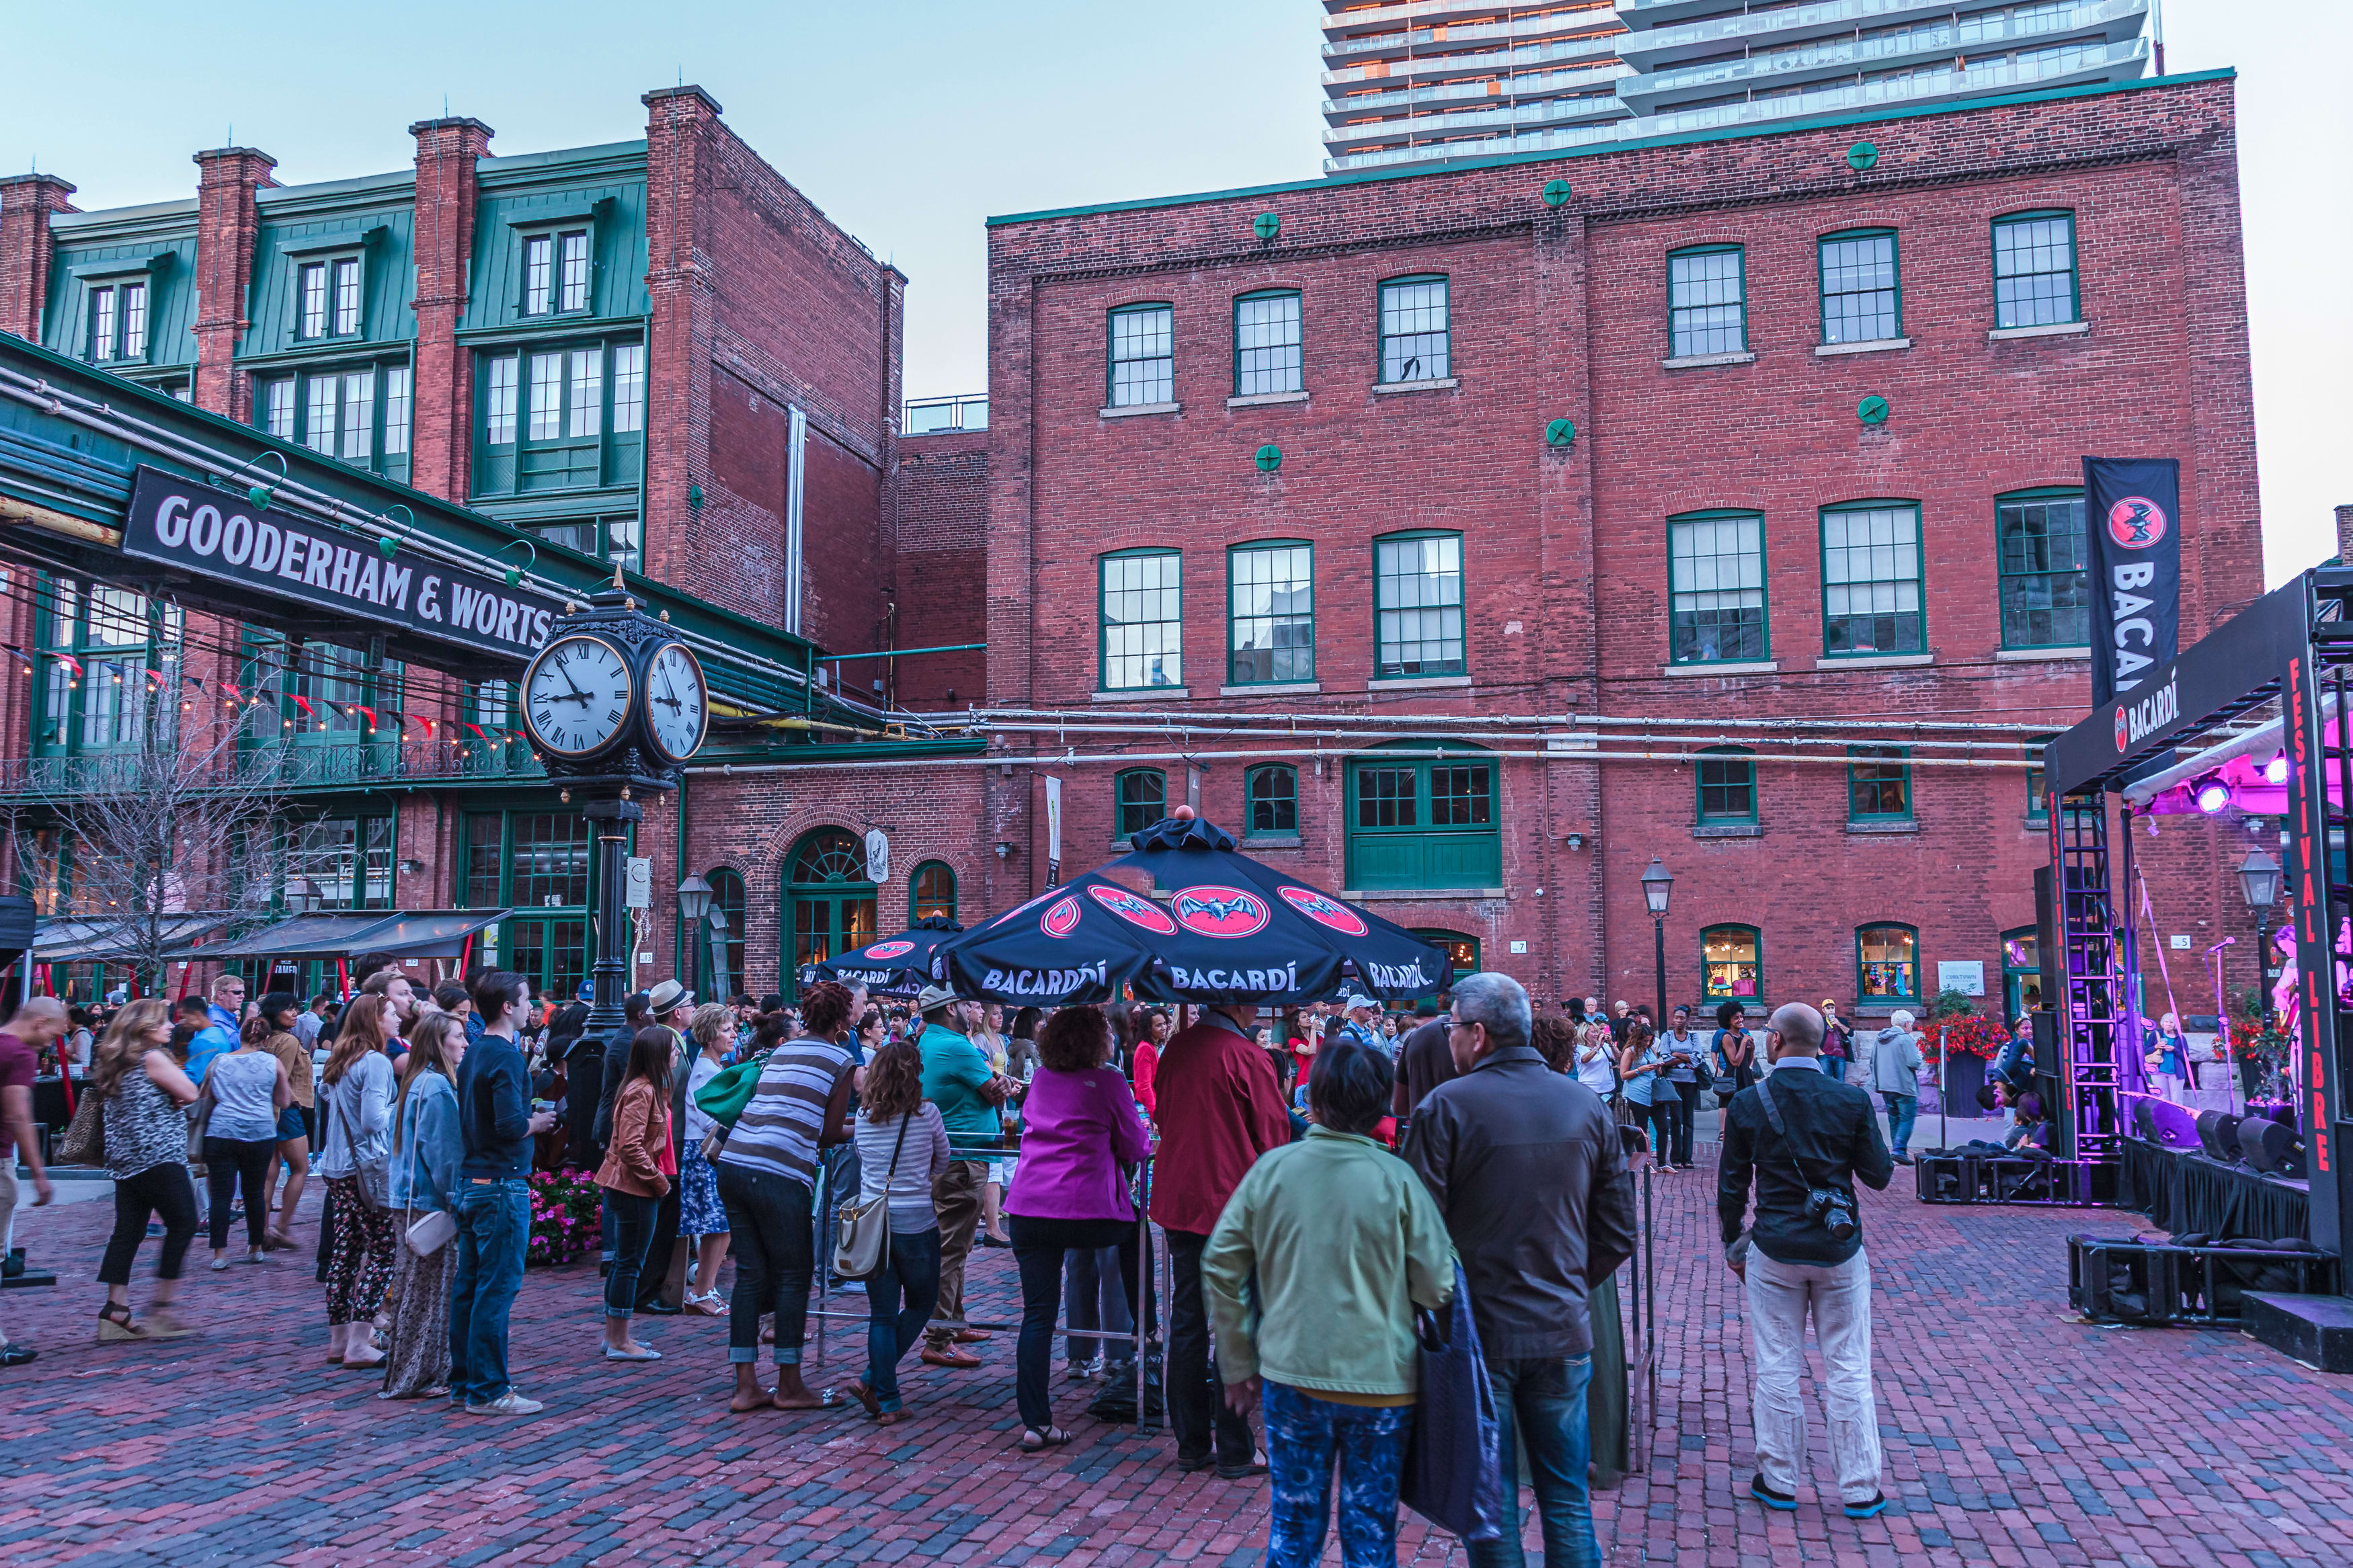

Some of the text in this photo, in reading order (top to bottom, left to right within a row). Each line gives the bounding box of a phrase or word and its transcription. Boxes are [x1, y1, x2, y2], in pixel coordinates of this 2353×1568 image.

[155, 495, 551, 650] GOODERHAM & WORTS
[2113, 561, 2155, 692] BACA
[1519, 943, 1524, 951] 7
[2288, 657, 2329, 1172] FESTIVAL LIBRE
